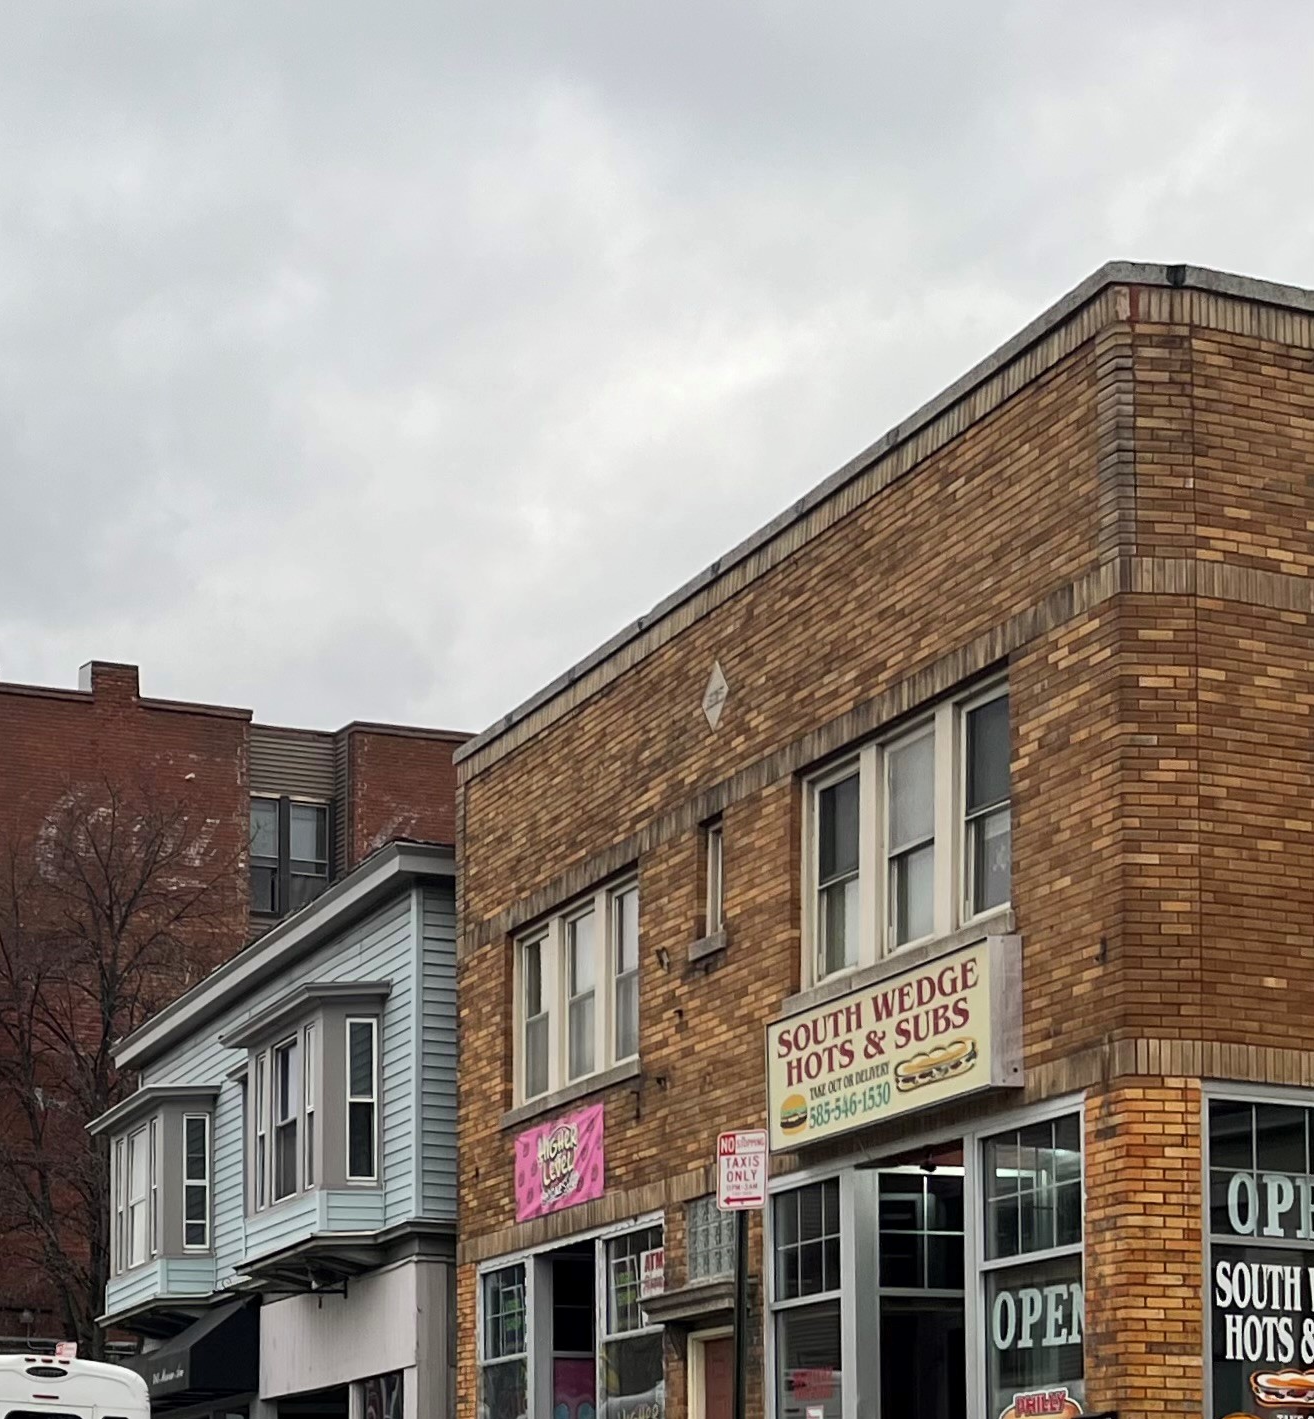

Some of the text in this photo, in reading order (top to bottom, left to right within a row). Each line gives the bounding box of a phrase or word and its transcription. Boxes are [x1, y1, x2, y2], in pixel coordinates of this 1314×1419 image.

[777, 957, 979, 1059] SOUTH WEDGE
[785, 996, 970, 1088] HOTS & SUBS
[809, 1061, 891, 1100] TAKE OUT OR DELIVERY
[809, 1081, 892, 1129] 585-546-1530
[537, 1122, 578, 1161] HIGHER
[720, 1136, 735, 1154] NO
[726, 1155, 760, 1169] TAXIS
[542, 1150, 574, 1186] LEVEL
[726, 1169, 758, 1183] ONLY
[1227, 1172, 1314, 1240] OPE
[1215, 1260, 1302, 1312] SOUTH
[992, 1282, 1084, 1350] OPEN
[1224, 1314, 1295, 1364] HOTS
[1015, 1391, 1067, 1418] PHILLY
